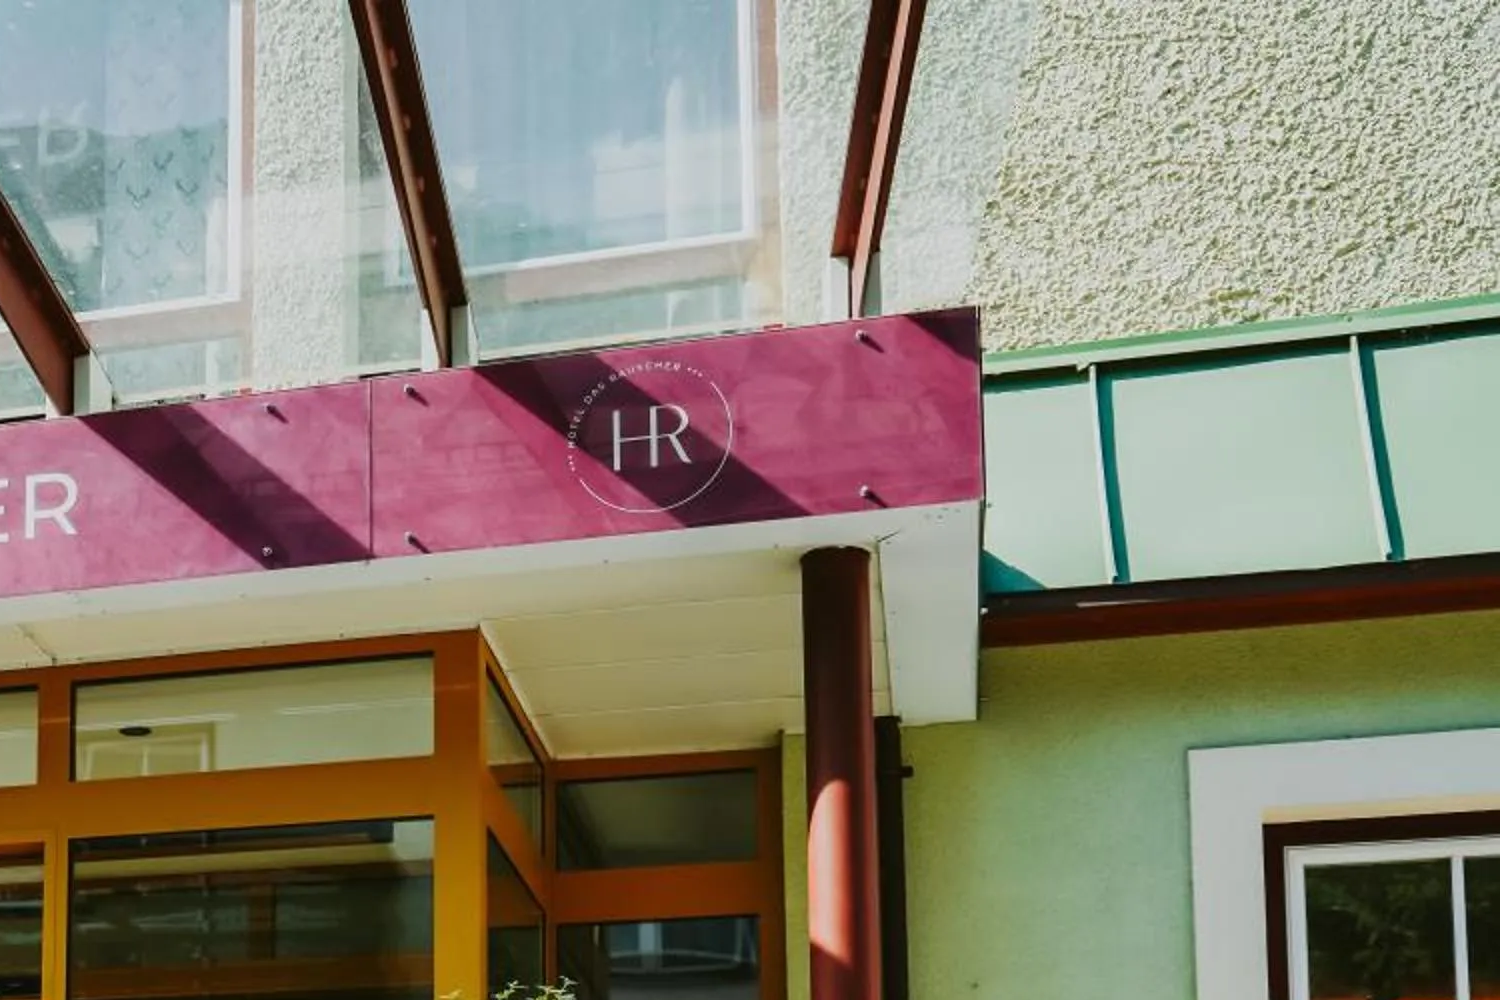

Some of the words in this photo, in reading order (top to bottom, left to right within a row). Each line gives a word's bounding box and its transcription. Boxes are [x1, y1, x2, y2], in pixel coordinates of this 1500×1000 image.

[583, 382, 605, 405] DAS
[608, 361, 682, 382] RAUSCHER
[612, 403, 693, 472] HR
